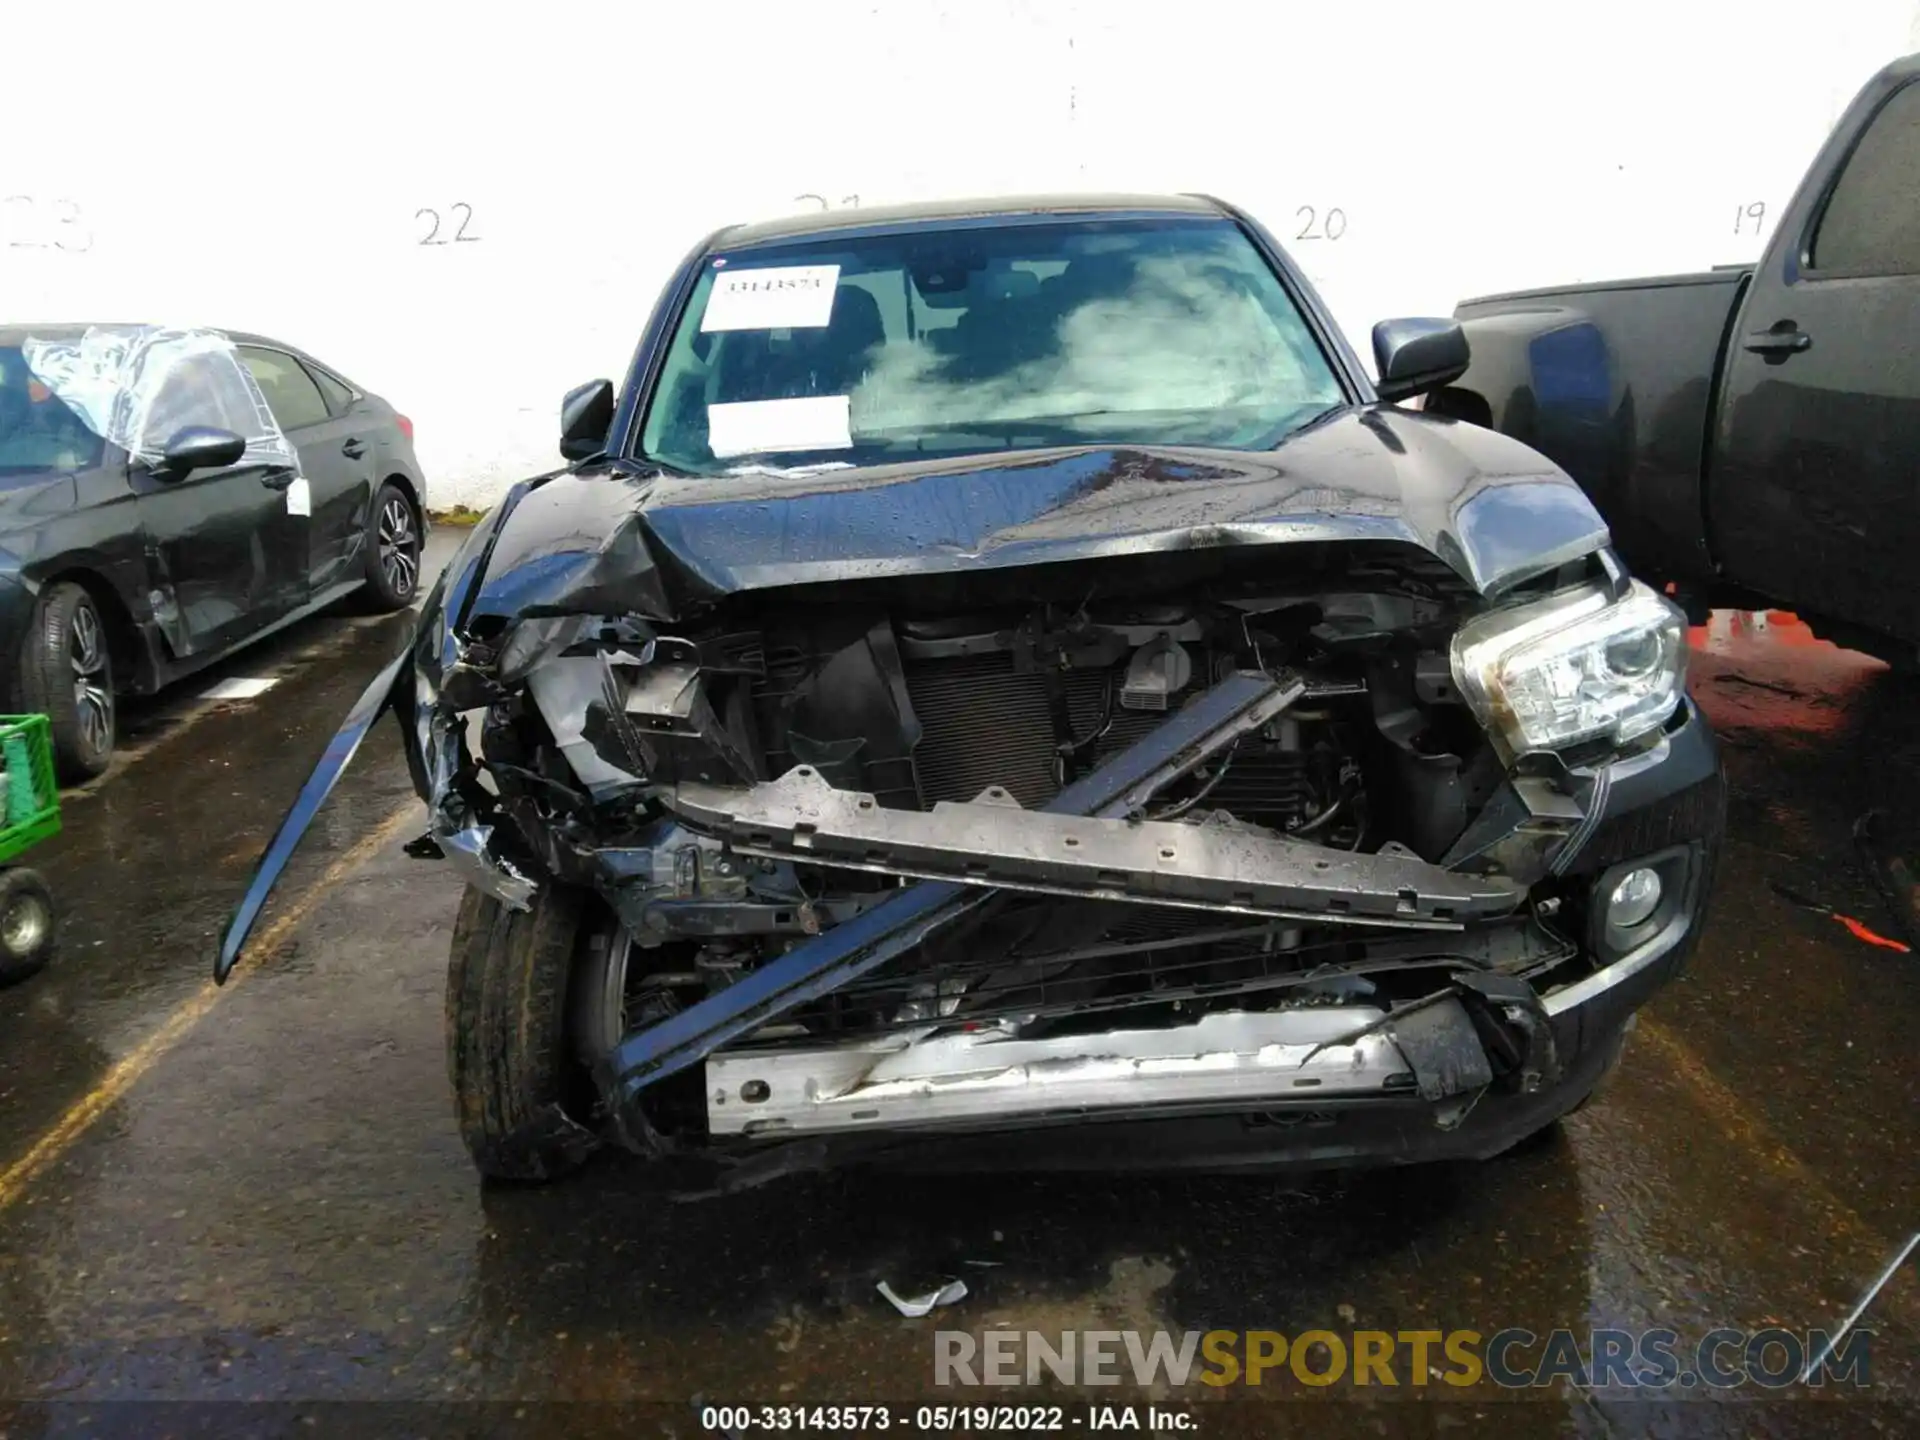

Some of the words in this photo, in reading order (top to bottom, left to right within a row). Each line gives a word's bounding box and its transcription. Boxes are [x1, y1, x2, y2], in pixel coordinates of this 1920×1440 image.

[415, 202, 482, 246] 22
[1296, 205, 1347, 240] 20
[1734, 201, 1765, 235] 19
